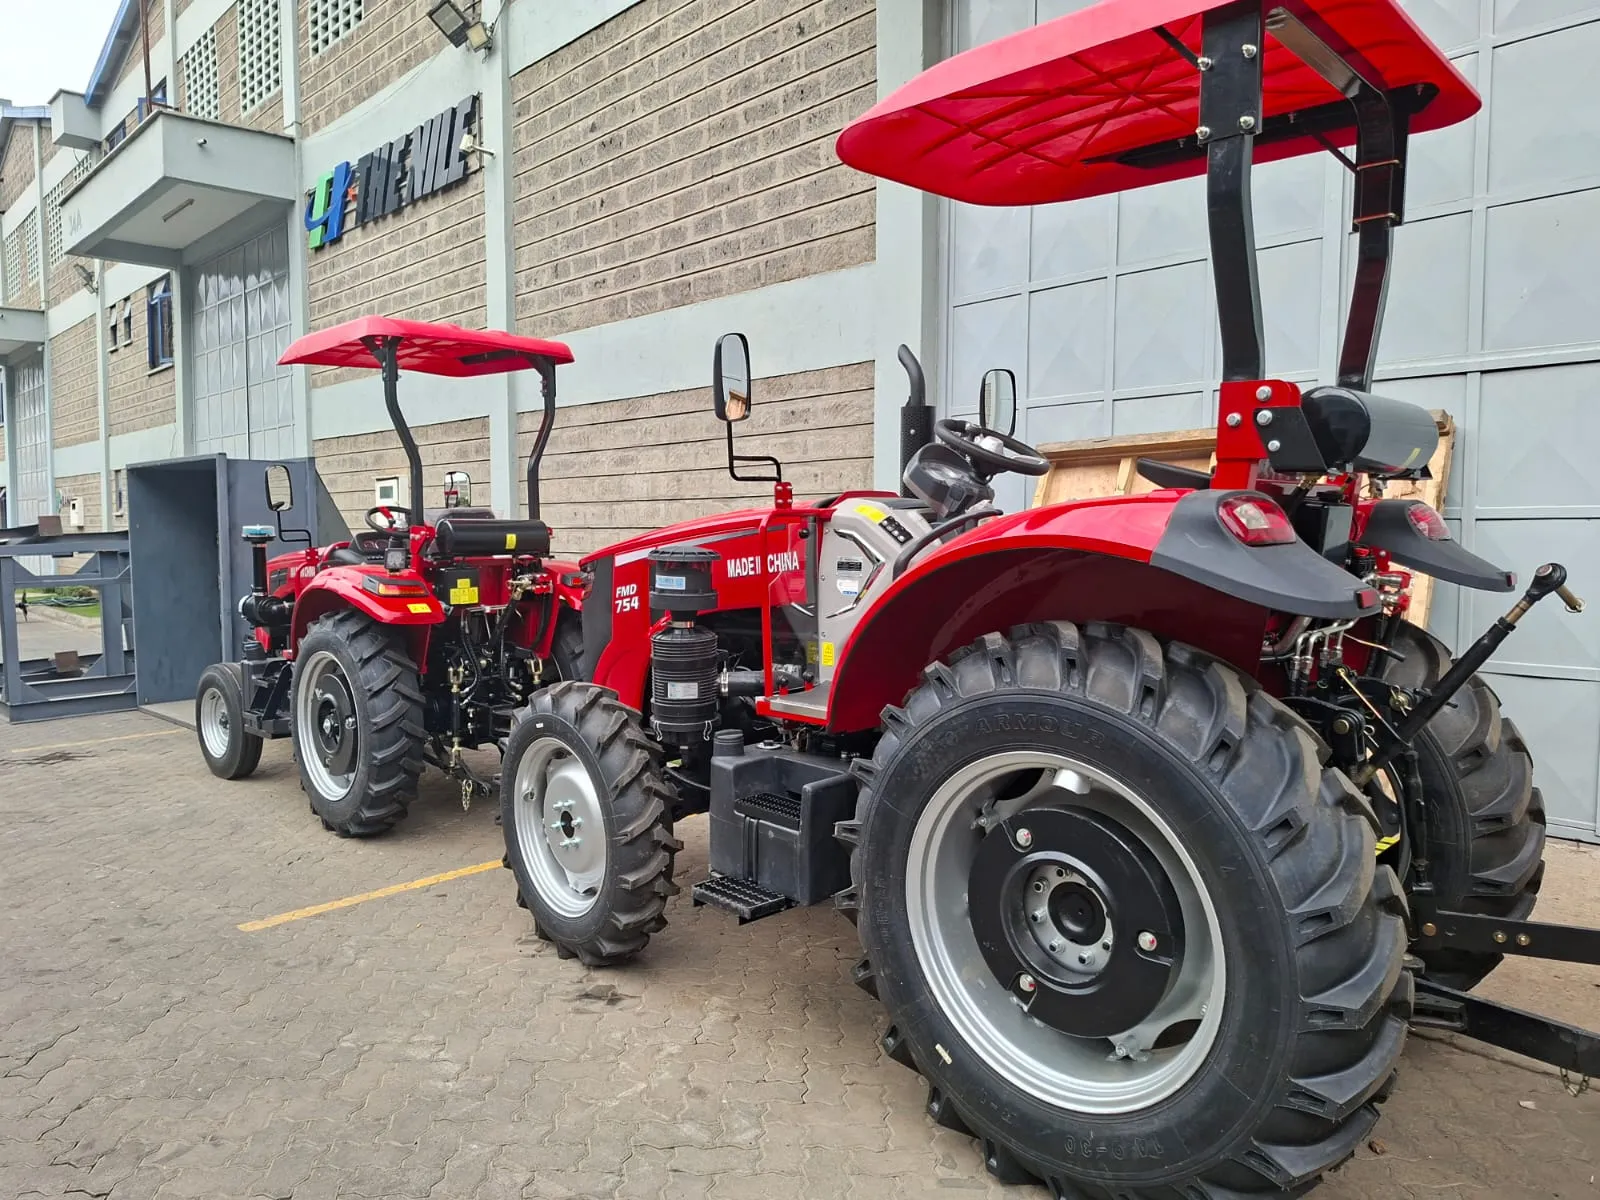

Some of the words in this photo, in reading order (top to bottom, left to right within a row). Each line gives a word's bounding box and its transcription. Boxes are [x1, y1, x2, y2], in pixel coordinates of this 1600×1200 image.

[355, 134, 406, 225] THE
[404, 94, 476, 202] NILE
[727, 556, 755, 578] MADE
[767, 550, 800, 573] CHINA
[614, 596, 639, 614] 754
[615, 583, 637, 599] FMD
[974, 712, 1106, 748] ARMOUR
